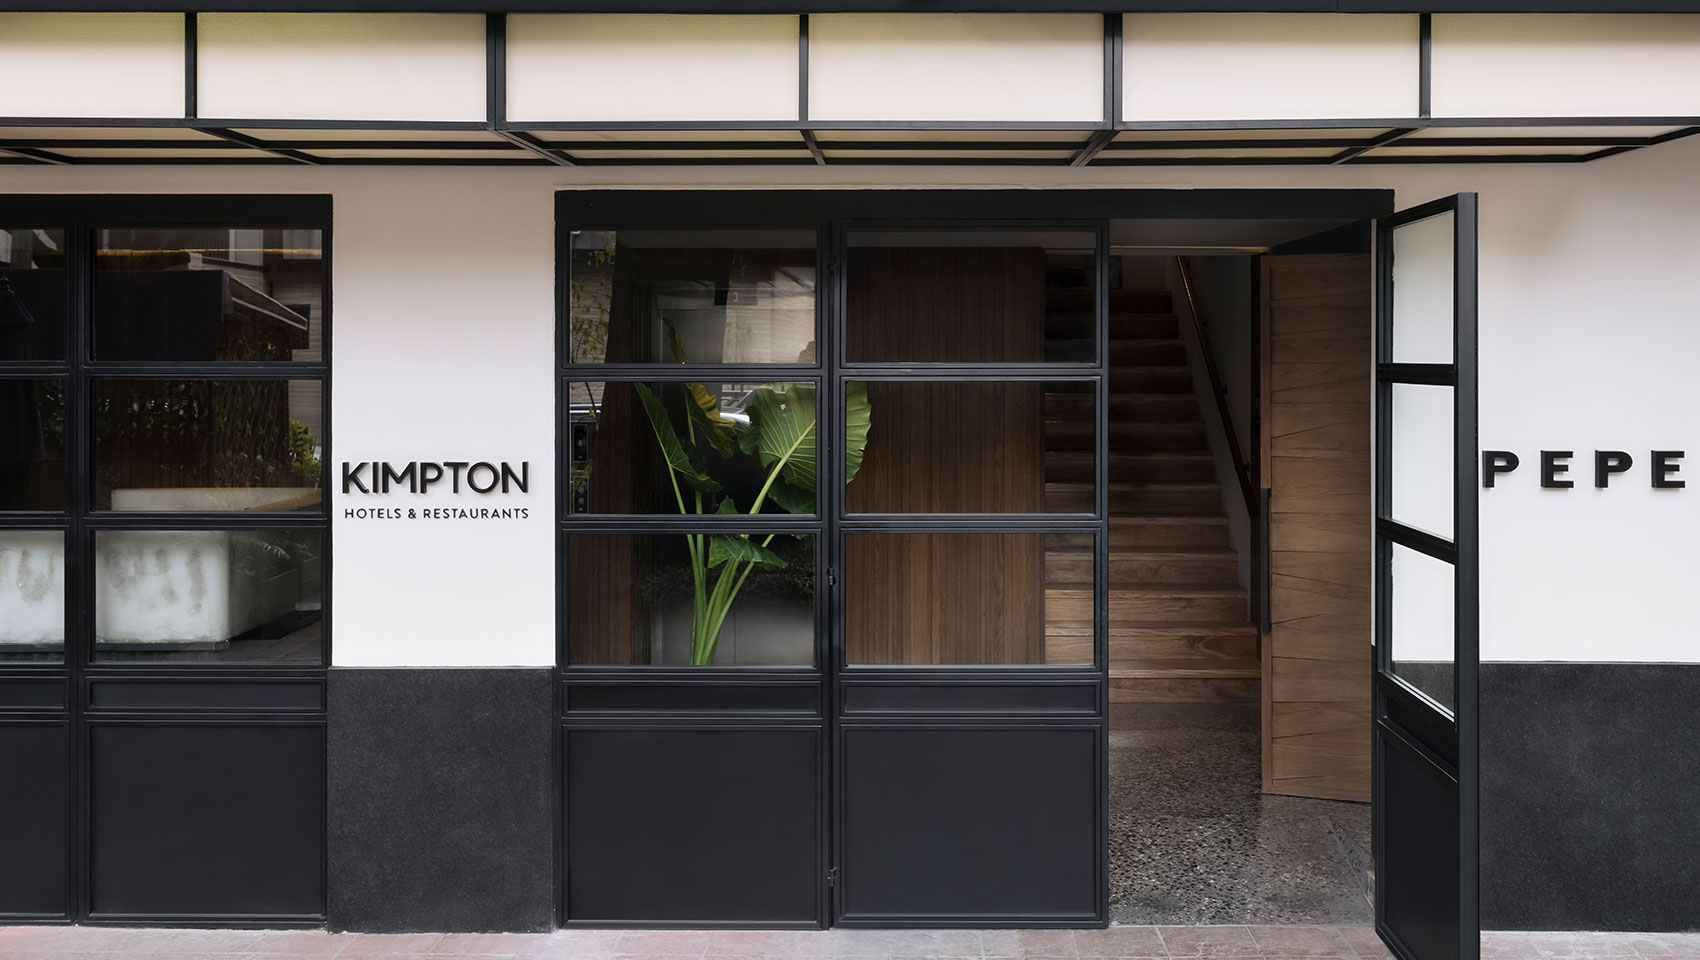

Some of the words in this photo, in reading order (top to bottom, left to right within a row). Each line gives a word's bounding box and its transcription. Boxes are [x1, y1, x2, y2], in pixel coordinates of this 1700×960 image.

[342, 461, 529, 494] KIMPTON
[1481, 449, 1686, 488] PEPE
[344, 508, 402, 519] HOTELS
[407, 508, 417, 519] &
[423, 508, 529, 519] RESTAURANTS
